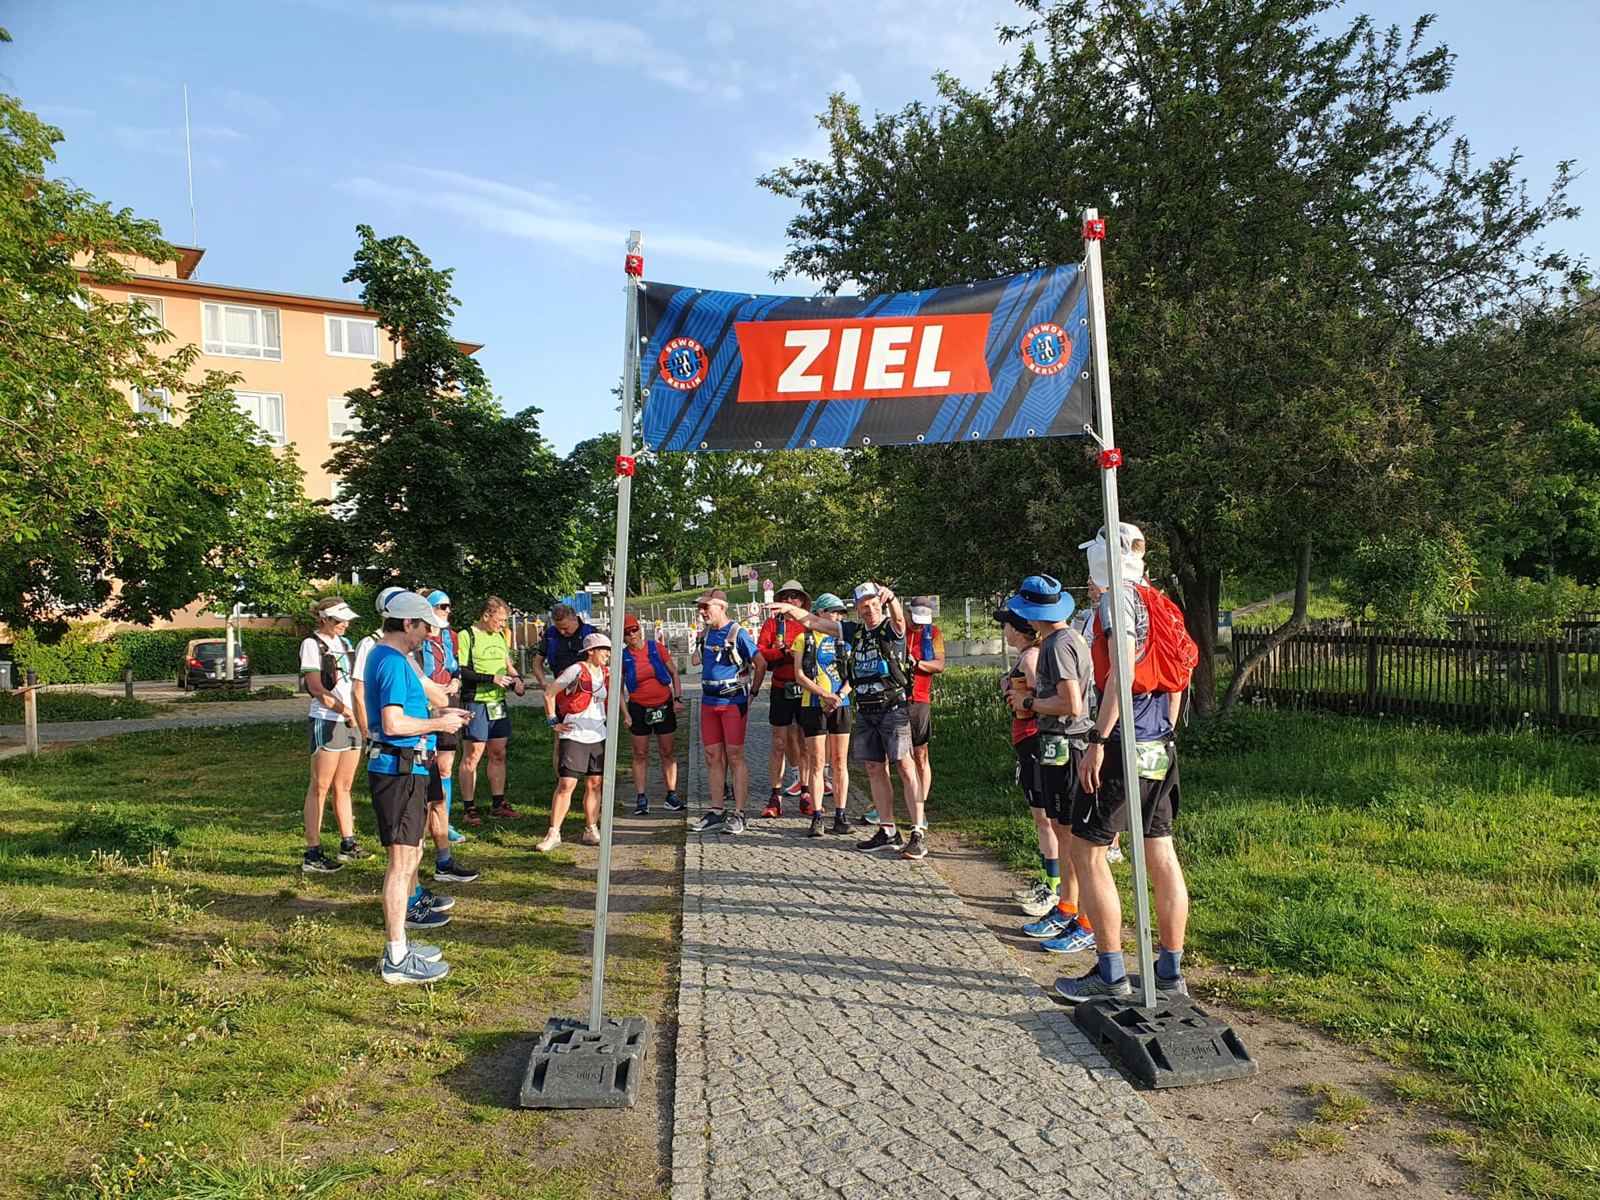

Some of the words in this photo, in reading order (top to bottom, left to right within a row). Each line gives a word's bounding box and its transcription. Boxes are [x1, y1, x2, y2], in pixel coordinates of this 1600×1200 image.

[777, 325, 951, 392] ZIEL
[1029, 345, 1066, 363] TOUR
[667, 361, 704, 378] TOUR
[1028, 362, 1064, 375] BERLIN
[667, 376, 702, 389] BERLIN
[651, 709, 663, 720] 20
